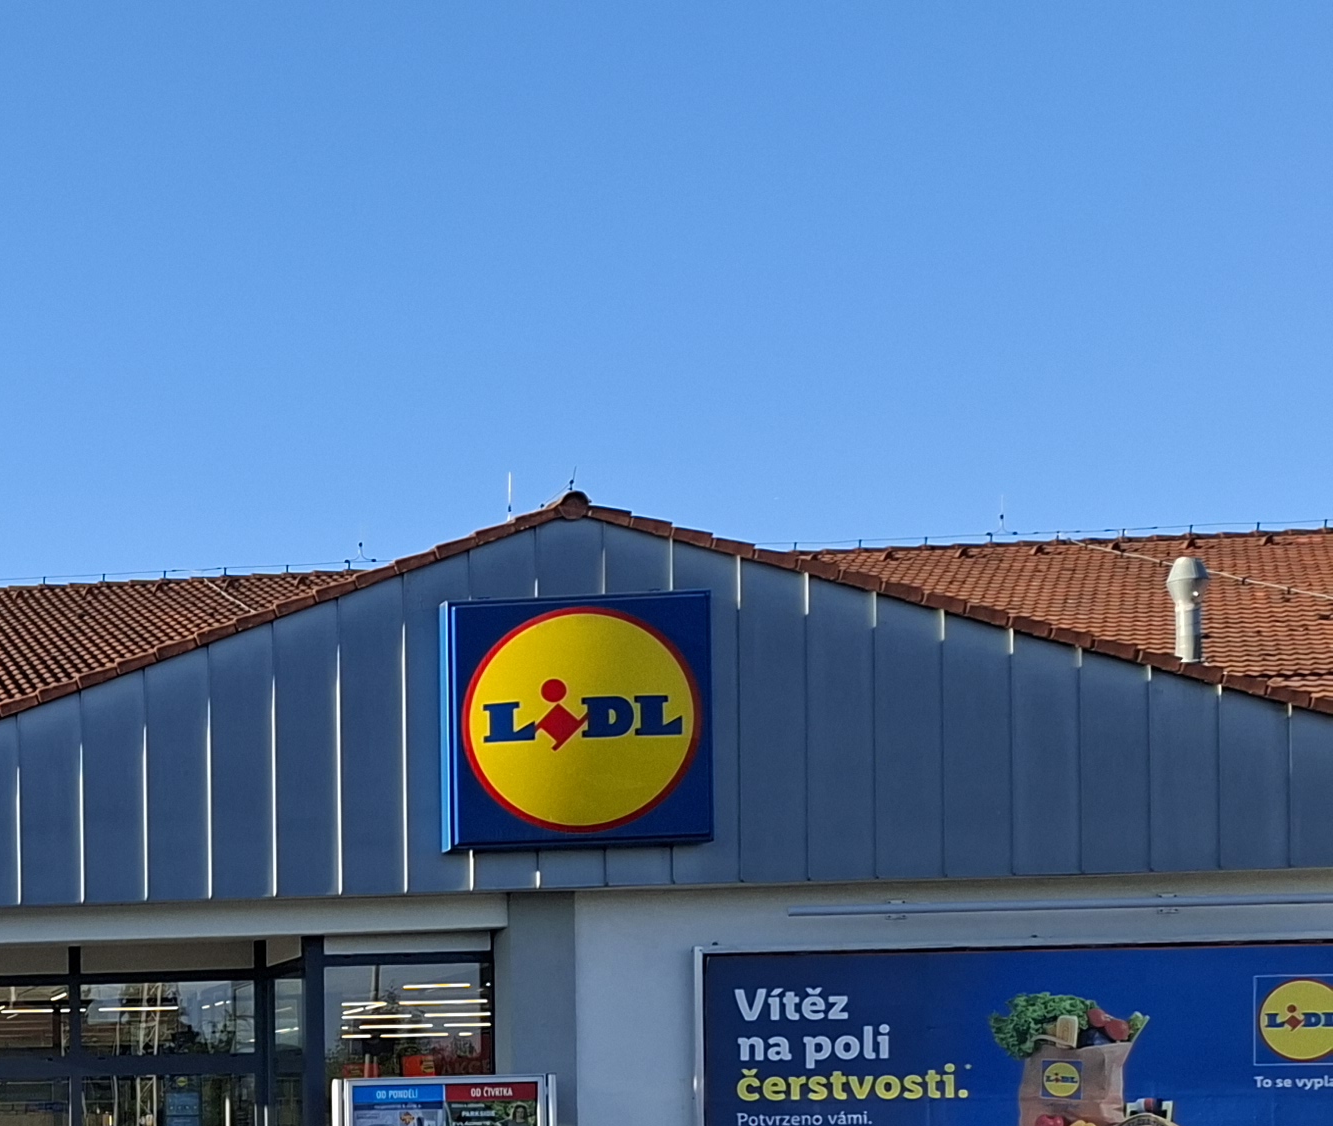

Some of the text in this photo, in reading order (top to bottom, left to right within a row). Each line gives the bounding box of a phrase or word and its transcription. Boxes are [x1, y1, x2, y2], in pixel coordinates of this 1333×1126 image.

[483, 678, 682, 751] LIDL
[734, 987, 849, 1021] Vítěz
[737, 1024, 890, 1069] na poli
[1254, 1076, 1272, 1089] To
[1275, 1078, 1292, 1088] se
[376, 1089, 386, 1099] OD
[470, 1086, 513, 1097] OD ČTVRTKA
[737, 1111, 873, 1126] Potvrzeno vámi.
